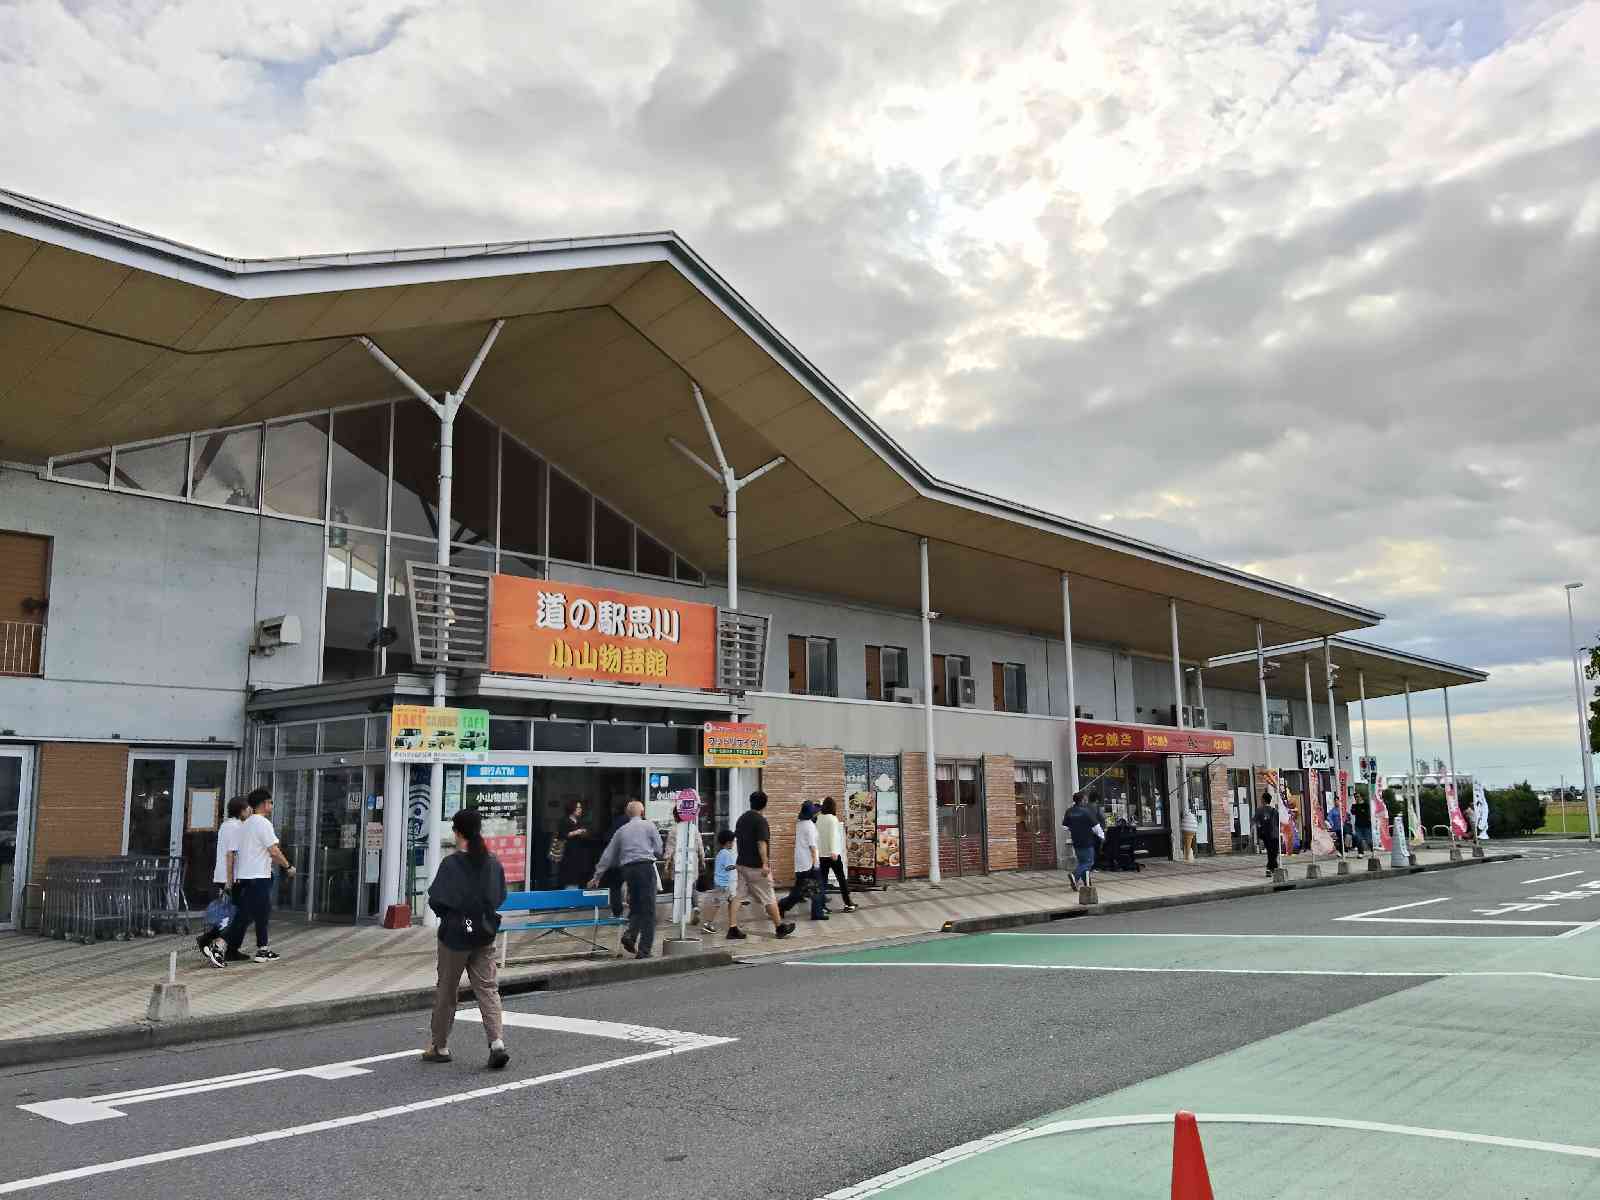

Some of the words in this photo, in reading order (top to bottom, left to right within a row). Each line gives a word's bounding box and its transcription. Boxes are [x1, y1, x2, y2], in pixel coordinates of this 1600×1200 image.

[536, 590, 681, 644] 道の駅思川
[552, 639, 668, 677] 小山物語館
[1080, 732, 1133, 747] たこ焼き
